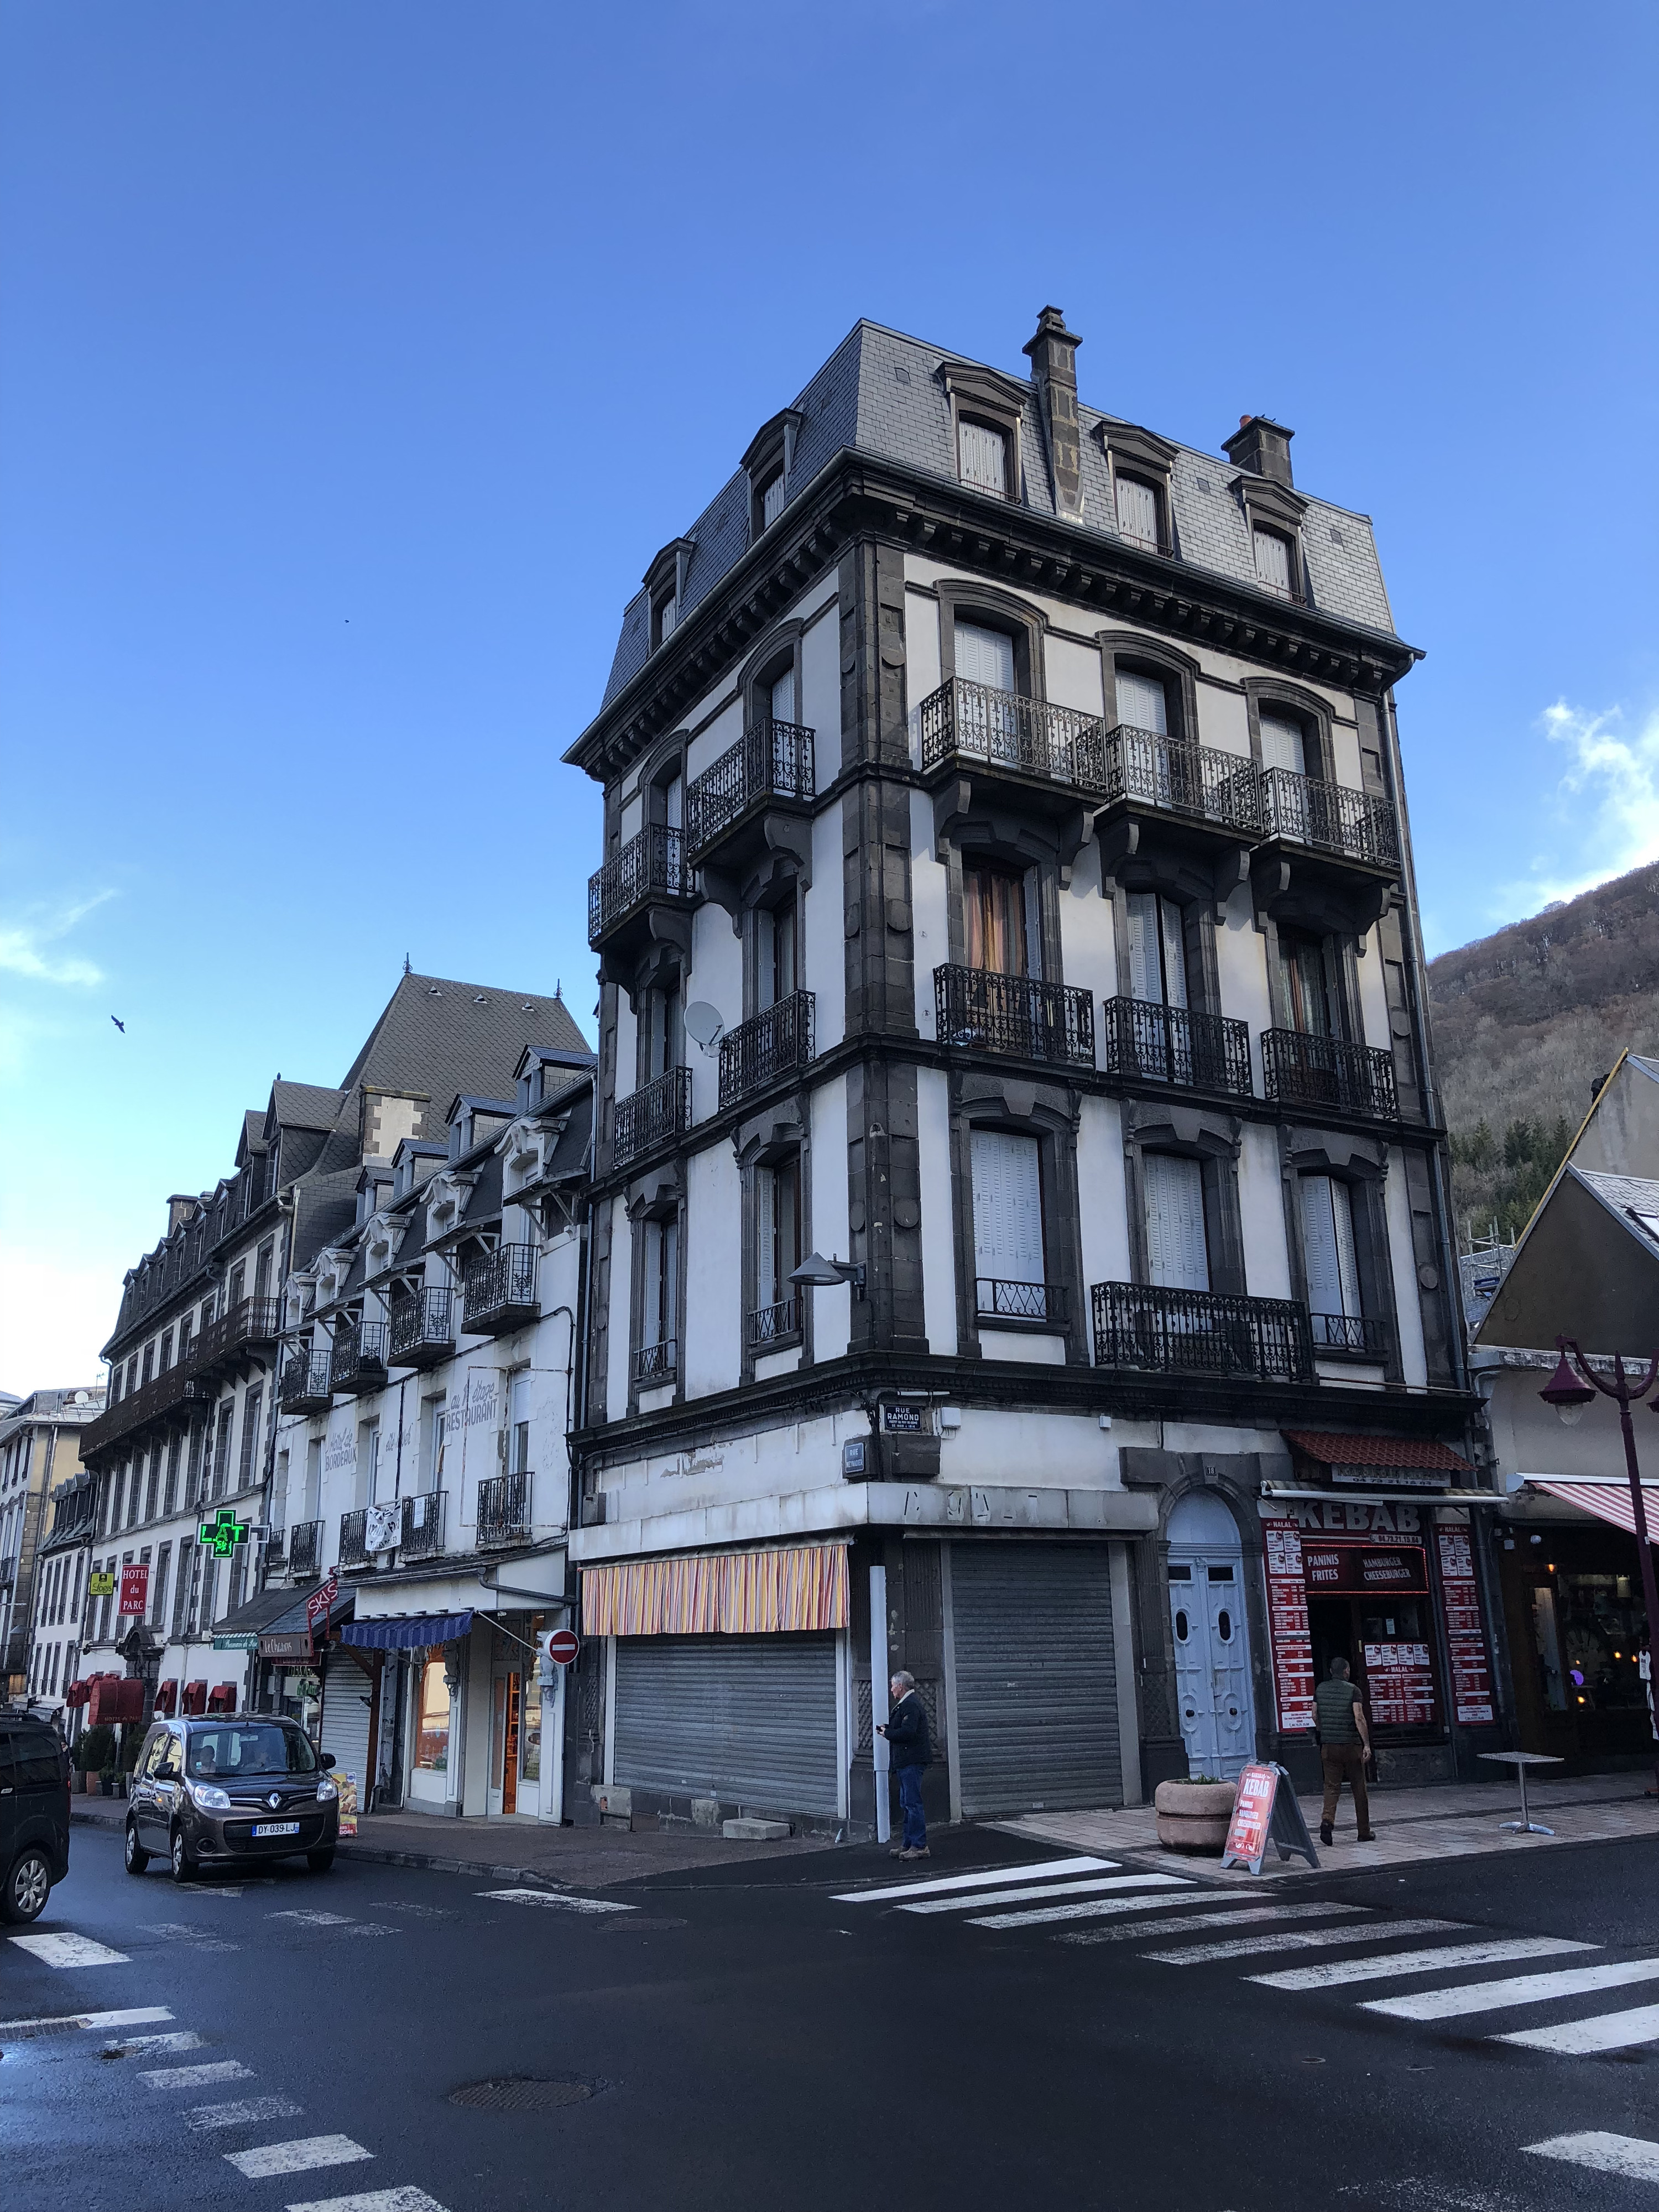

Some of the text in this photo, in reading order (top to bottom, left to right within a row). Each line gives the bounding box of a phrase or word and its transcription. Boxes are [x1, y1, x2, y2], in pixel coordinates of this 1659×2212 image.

[446, 1398, 497, 1433] RESTAURANT
[887, 1412, 919, 1421] RAMOND
[849, 1448, 859, 1456] RUE
[325, 1446, 357, 1472] BORDEAUX
[1298, 1500, 1420, 1532] KEBAB
[1307, 1553, 1339, 1567] PANINIS
[1362, 1557, 1403, 1568] HAMBURGER
[122, 1569, 148, 1580] HOTEL
[1311, 1569, 1339, 1582] FRITES
[1363, 1568, 1412, 1582] CHEESEBURGER
[92, 1583, 112, 1593] Logis
[130, 1584, 139, 1594] du
[122, 1600, 144, 1610] PARC
[307, 1582, 338, 1615] SKIS
[1243, 1778, 1270, 1797] KEBAB
